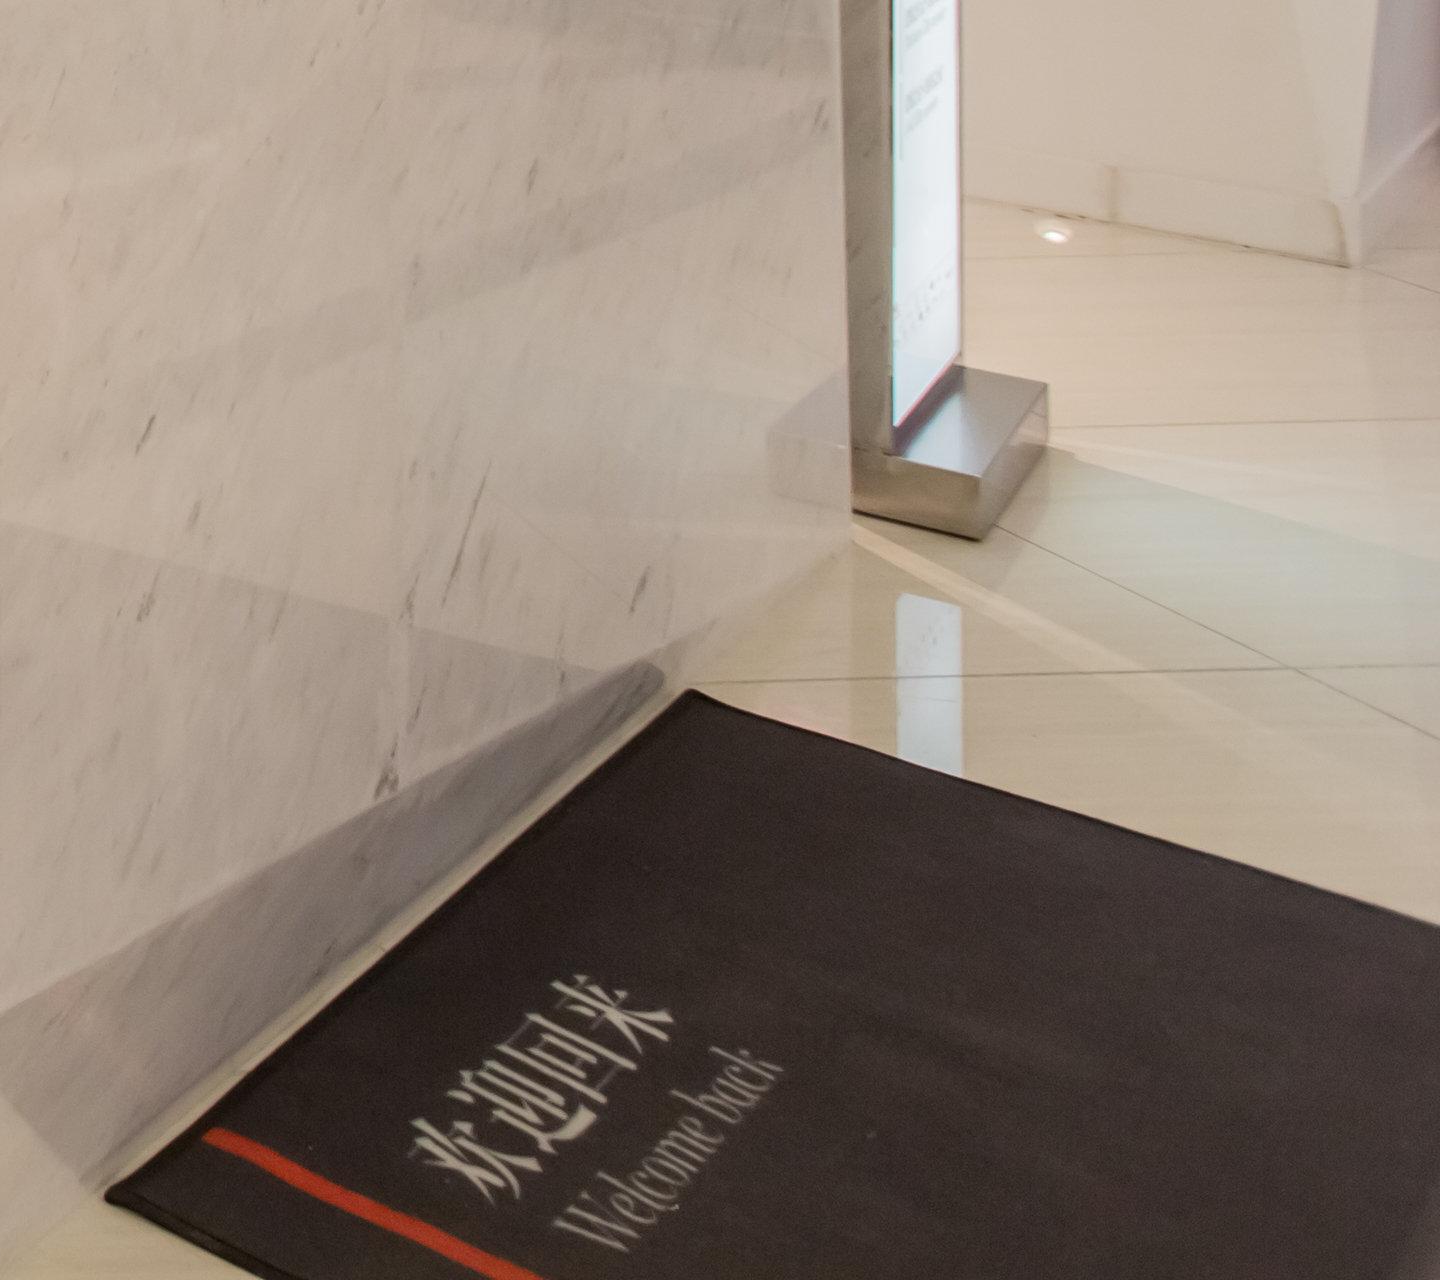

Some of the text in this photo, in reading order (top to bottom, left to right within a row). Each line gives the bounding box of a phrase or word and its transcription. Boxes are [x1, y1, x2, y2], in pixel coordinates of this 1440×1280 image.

[407, 971, 675, 1208] 欢迎回来
[552, 1044, 786, 1253] Welcome back
